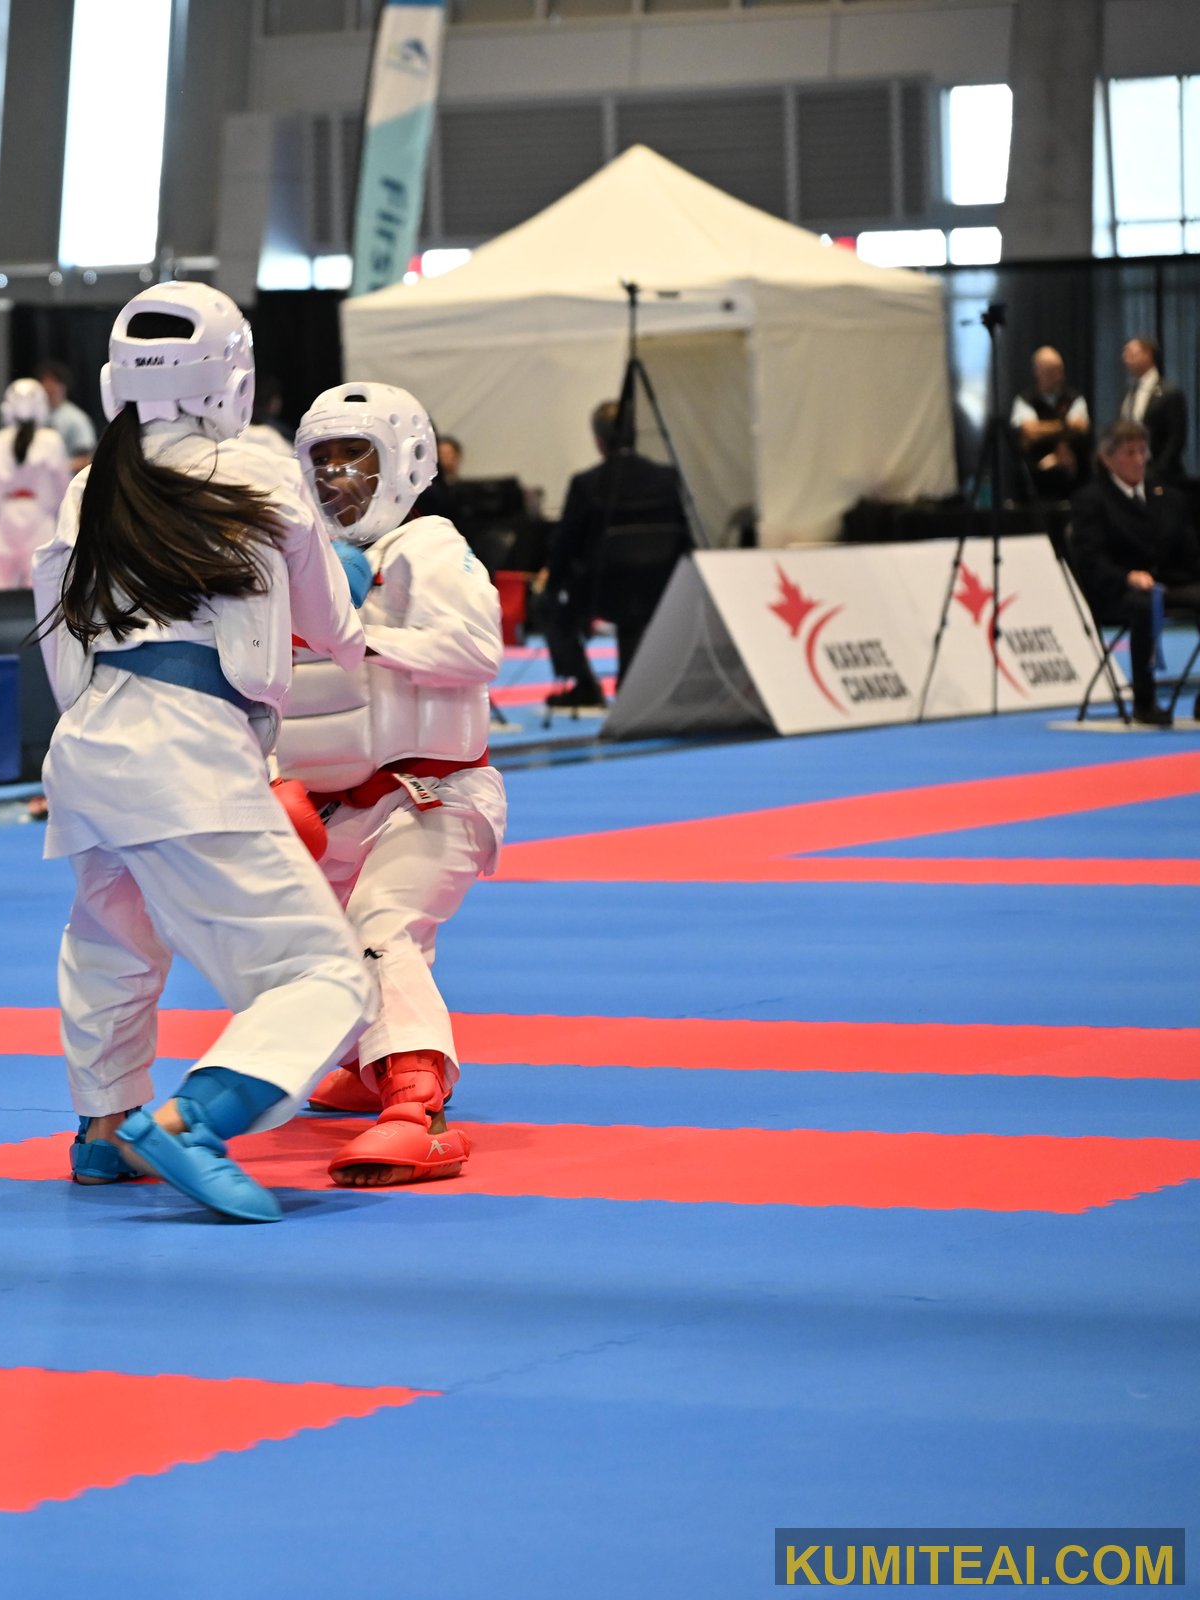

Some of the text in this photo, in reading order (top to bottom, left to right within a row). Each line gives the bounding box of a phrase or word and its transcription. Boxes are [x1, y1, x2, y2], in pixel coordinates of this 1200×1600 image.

[824, 639, 893, 670] KARATE
[1004, 627, 1063, 655] KARATE
[1019, 658, 1080, 686] CANADA
[841, 672, 911, 703] CANADA
